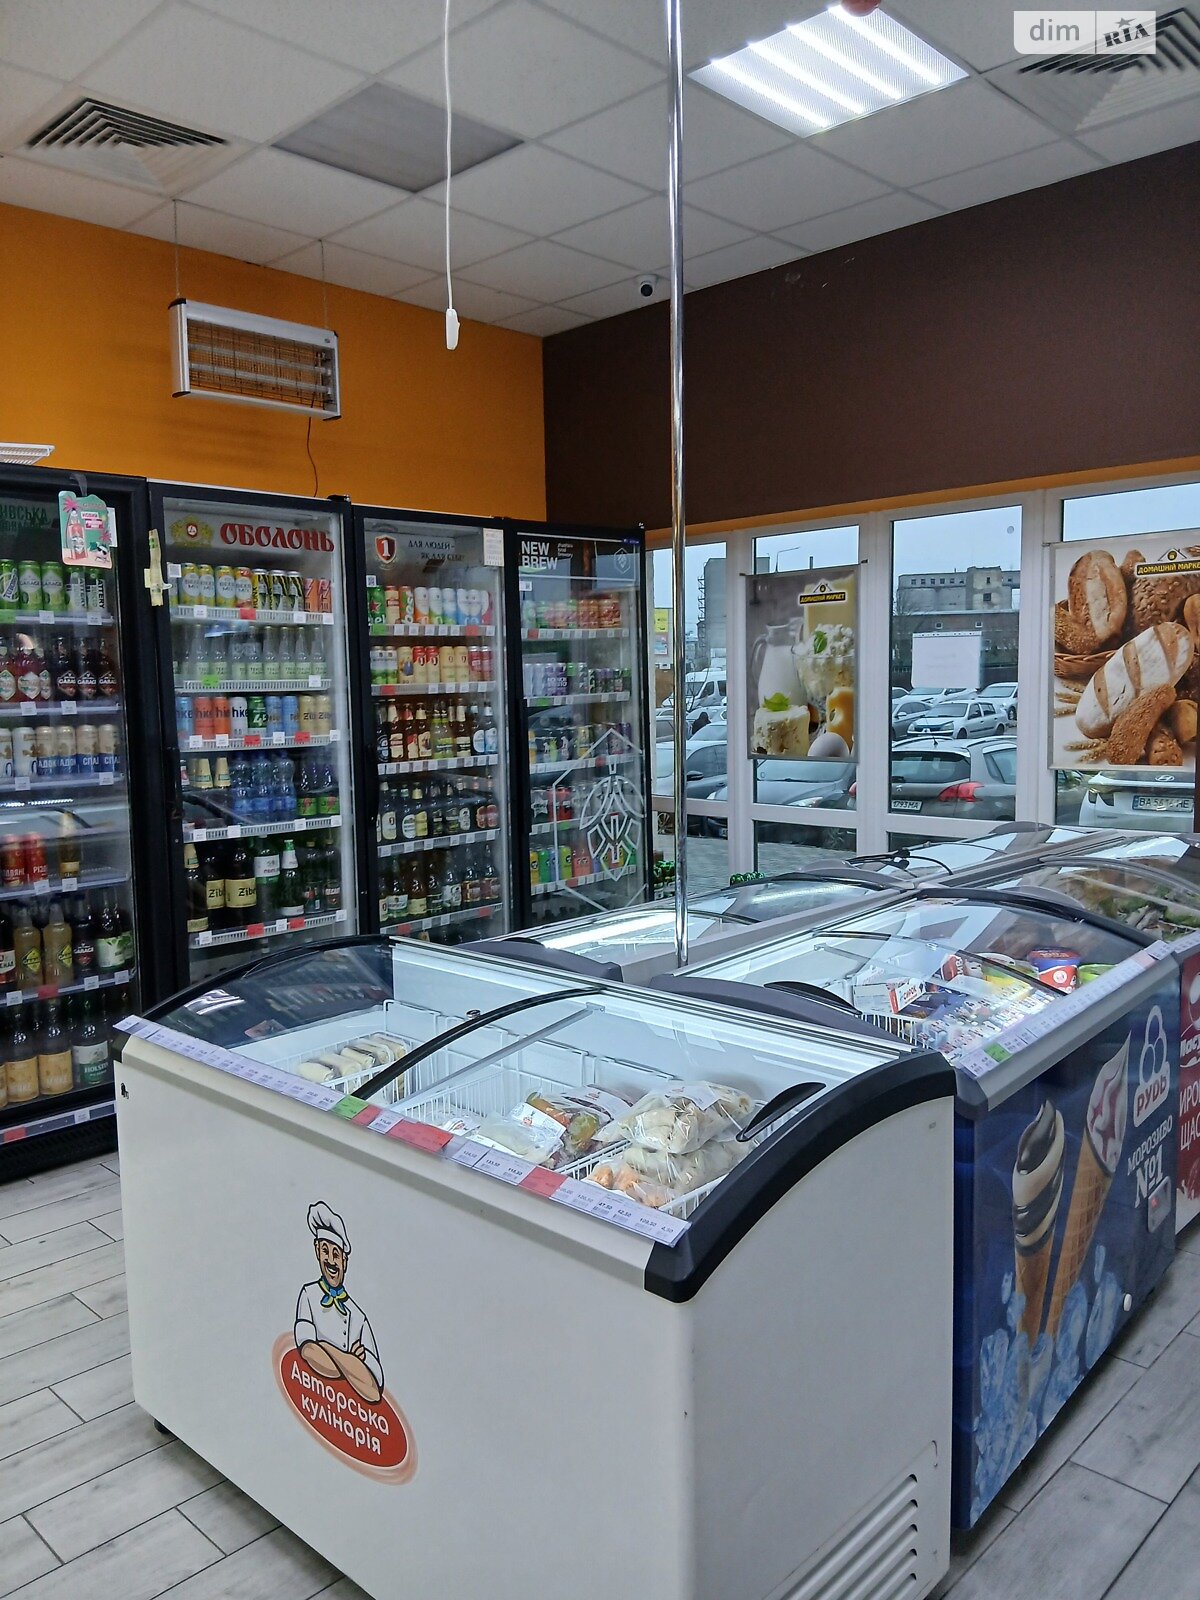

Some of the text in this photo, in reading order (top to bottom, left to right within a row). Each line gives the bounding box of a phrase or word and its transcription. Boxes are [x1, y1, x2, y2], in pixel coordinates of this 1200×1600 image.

[220, 522, 335, 552] ОБОЛОНЬ
[521, 541, 550, 556] NEW
[522, 555, 558, 570] BREW
[1137, 563, 1176, 574] ДОМАШНІЙ
[1136, 1075, 1168, 1118] РУДЬ
[1127, 1114, 1173, 1176] МОРОЗИВО
[290, 1360, 389, 1435] Авторська
[301, 1393, 382, 1455] кулінарія
